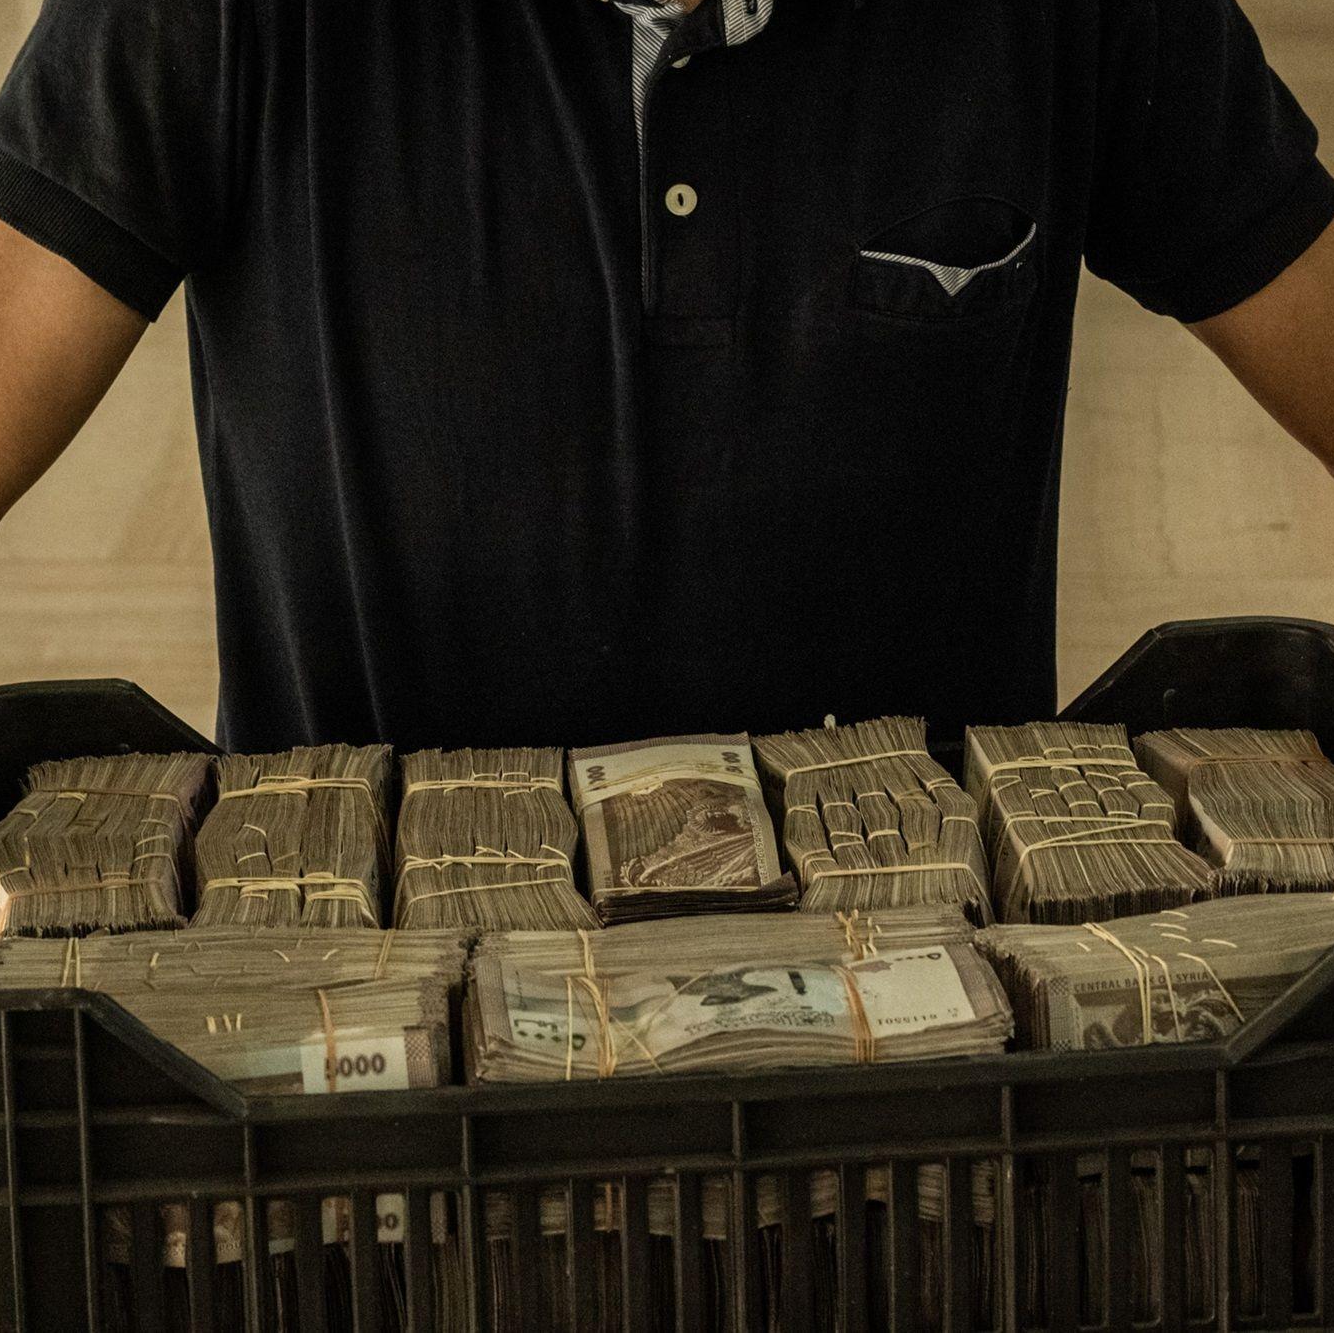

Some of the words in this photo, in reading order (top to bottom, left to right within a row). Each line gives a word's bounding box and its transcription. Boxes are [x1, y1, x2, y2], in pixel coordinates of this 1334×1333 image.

[1074, 979, 1122, 993] CENTRAL
[1125, 975, 1154, 988] BAK
[1176, 970, 1209, 983] SYRIA
